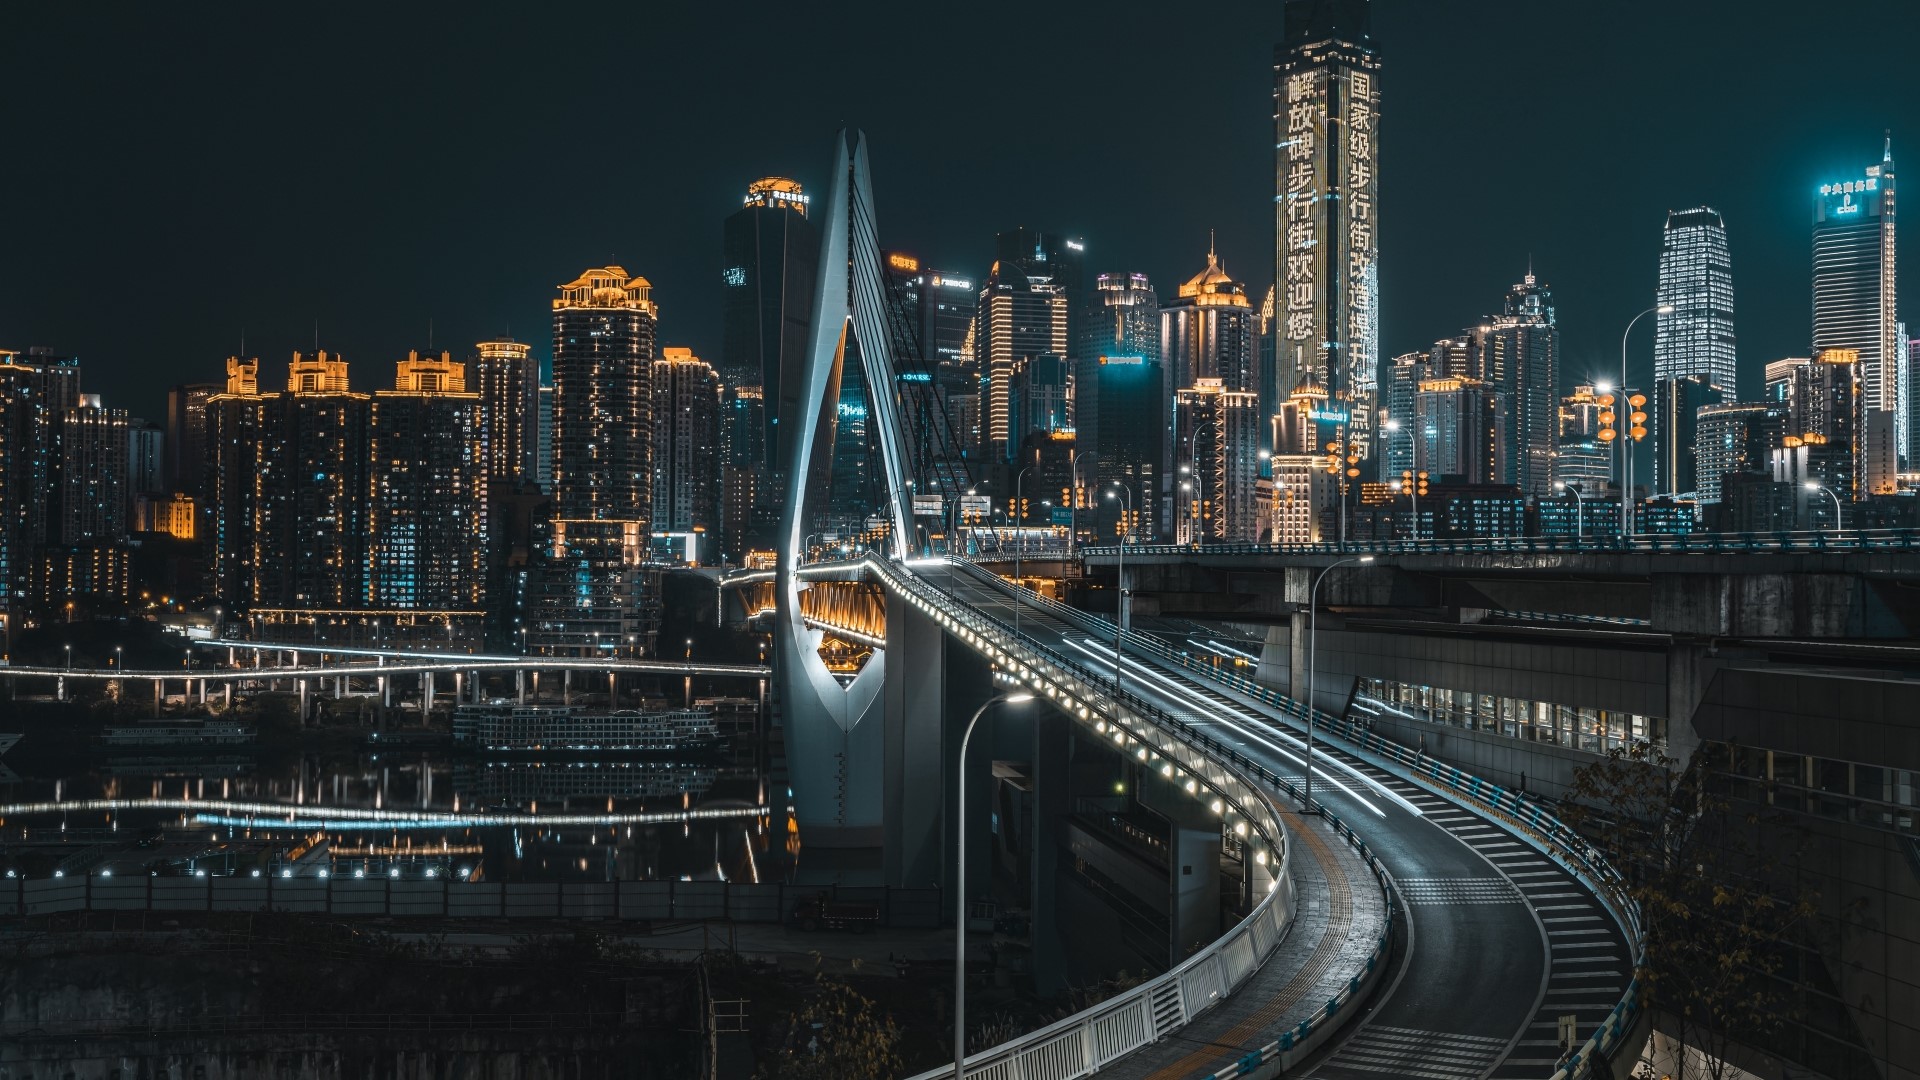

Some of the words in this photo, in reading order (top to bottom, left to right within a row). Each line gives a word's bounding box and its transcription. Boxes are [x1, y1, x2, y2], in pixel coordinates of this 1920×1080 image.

[1821, 180, 1876, 195] 中央商务区
